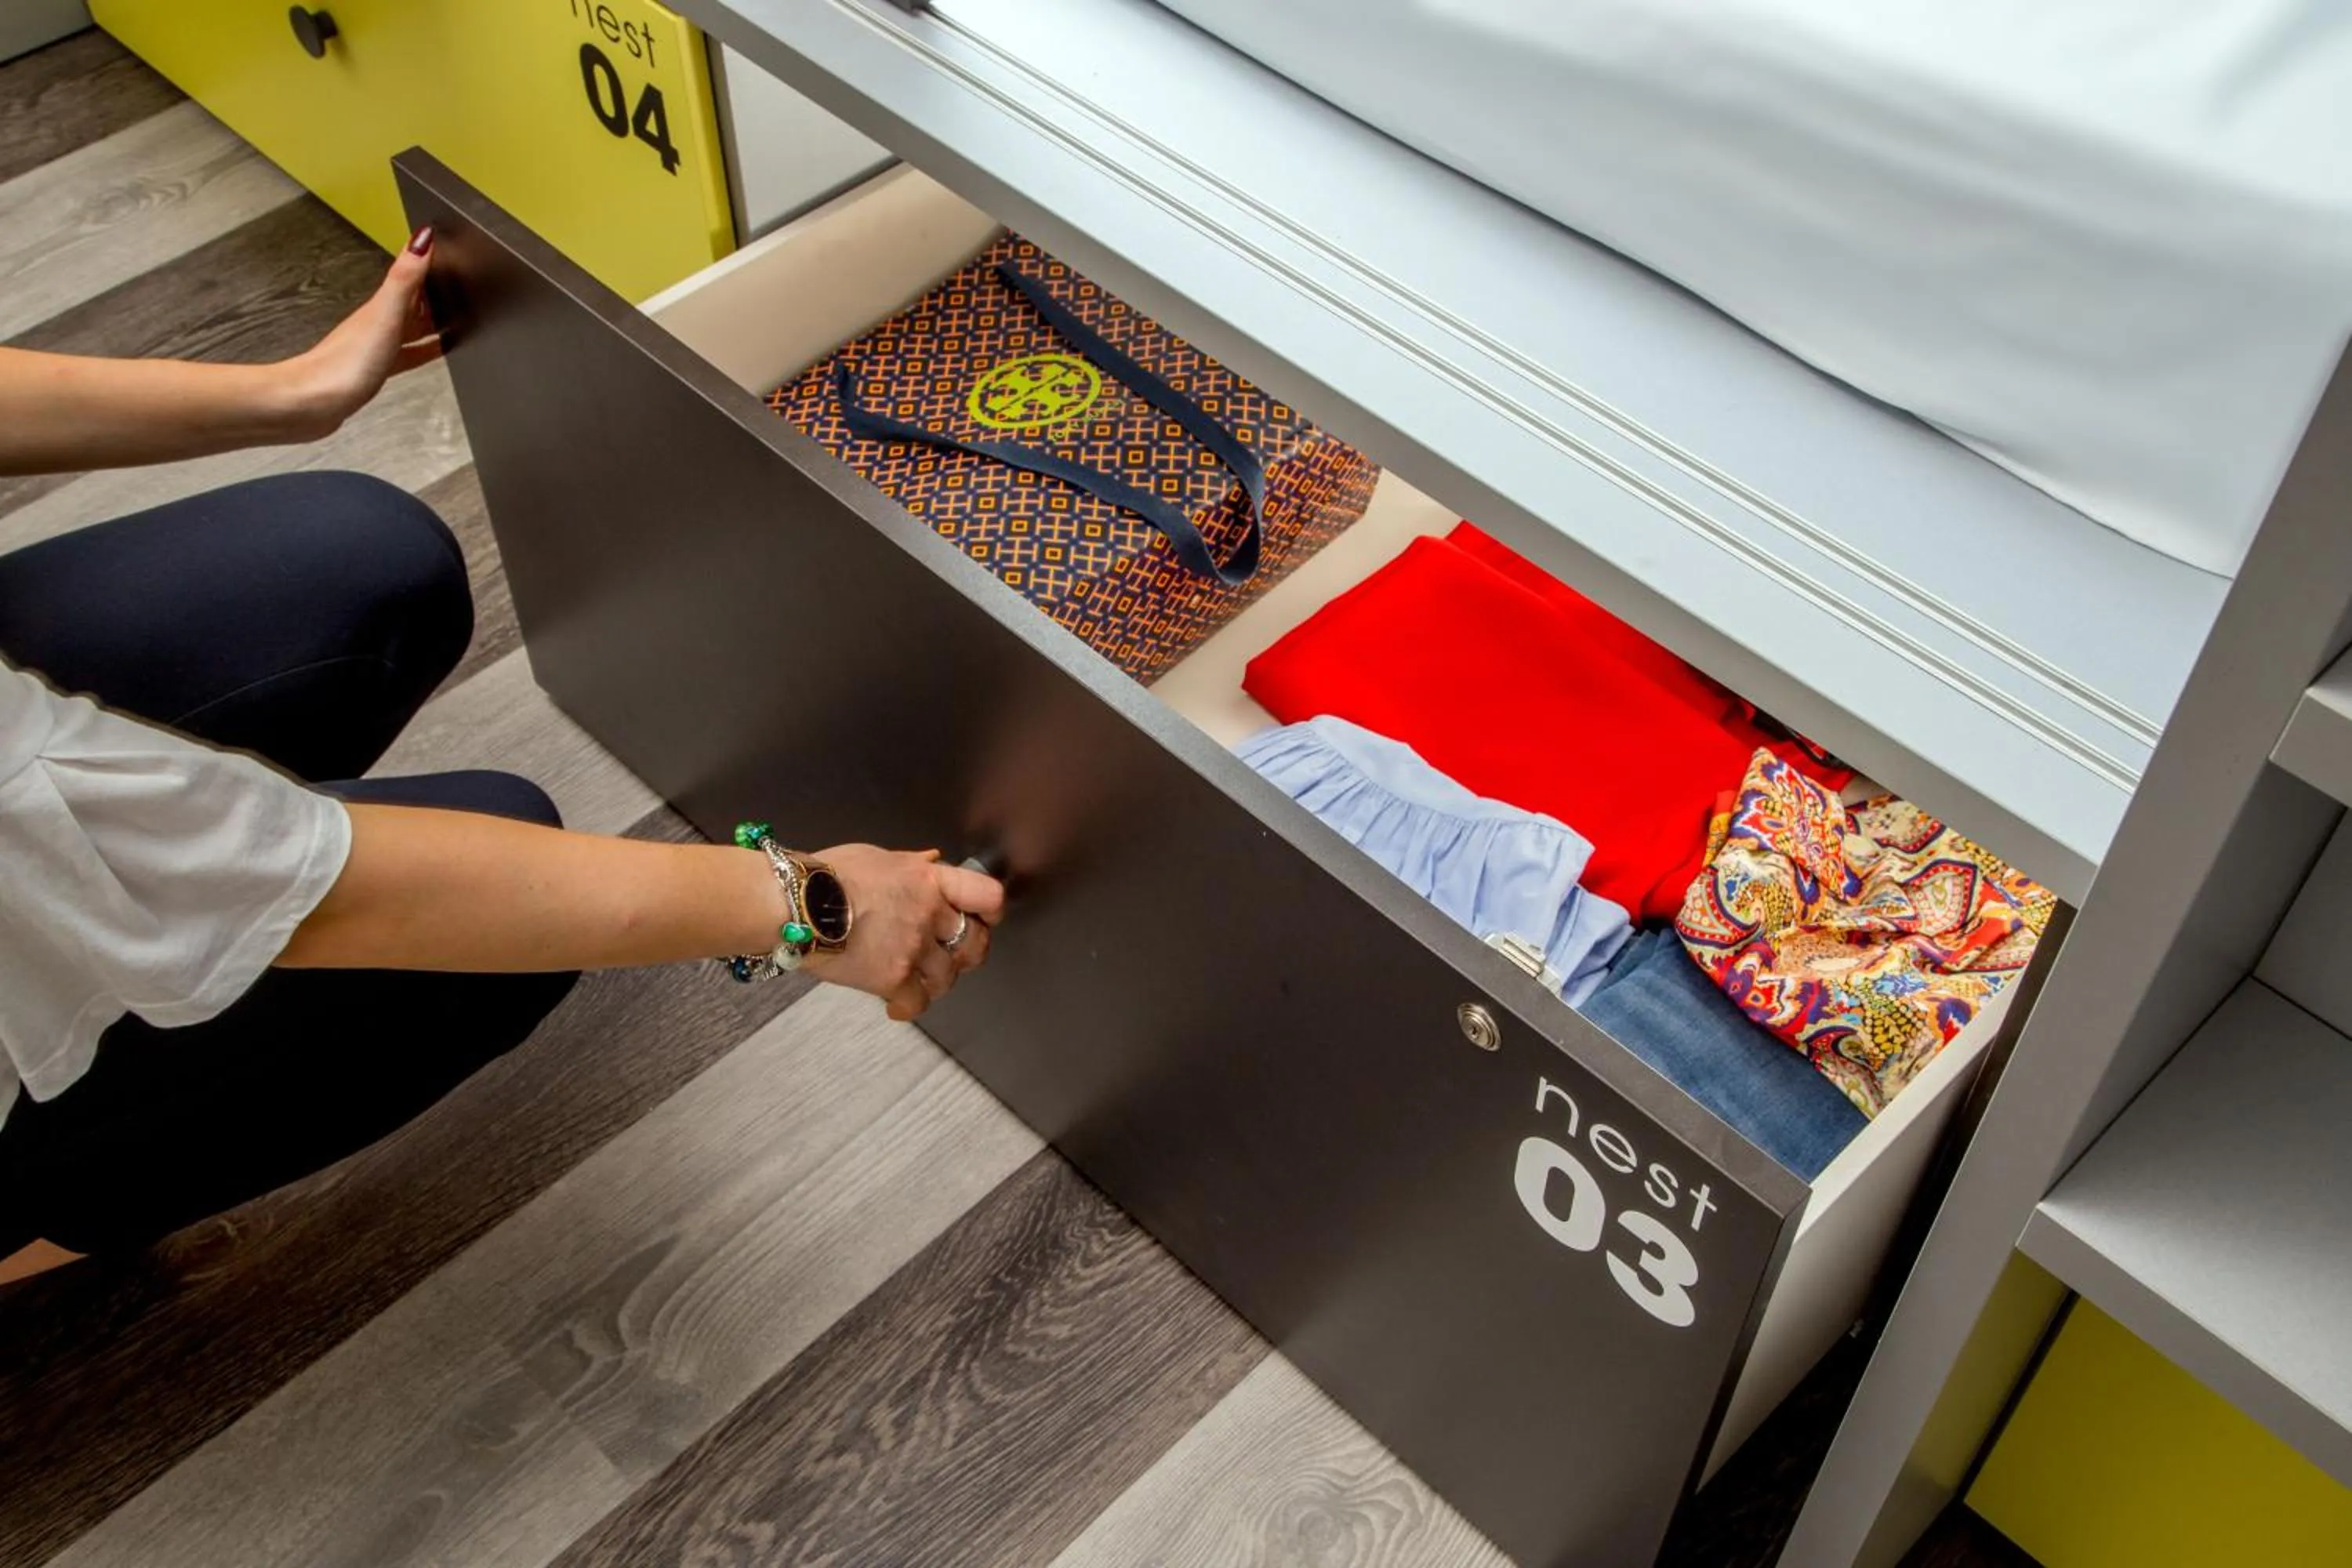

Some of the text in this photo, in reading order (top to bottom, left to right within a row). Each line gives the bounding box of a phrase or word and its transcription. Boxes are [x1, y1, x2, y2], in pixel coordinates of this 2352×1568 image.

[579, 43, 681, 176] 04
[1514, 1137, 1699, 1327] 03
[1535, 1076, 1718, 1232] nest
